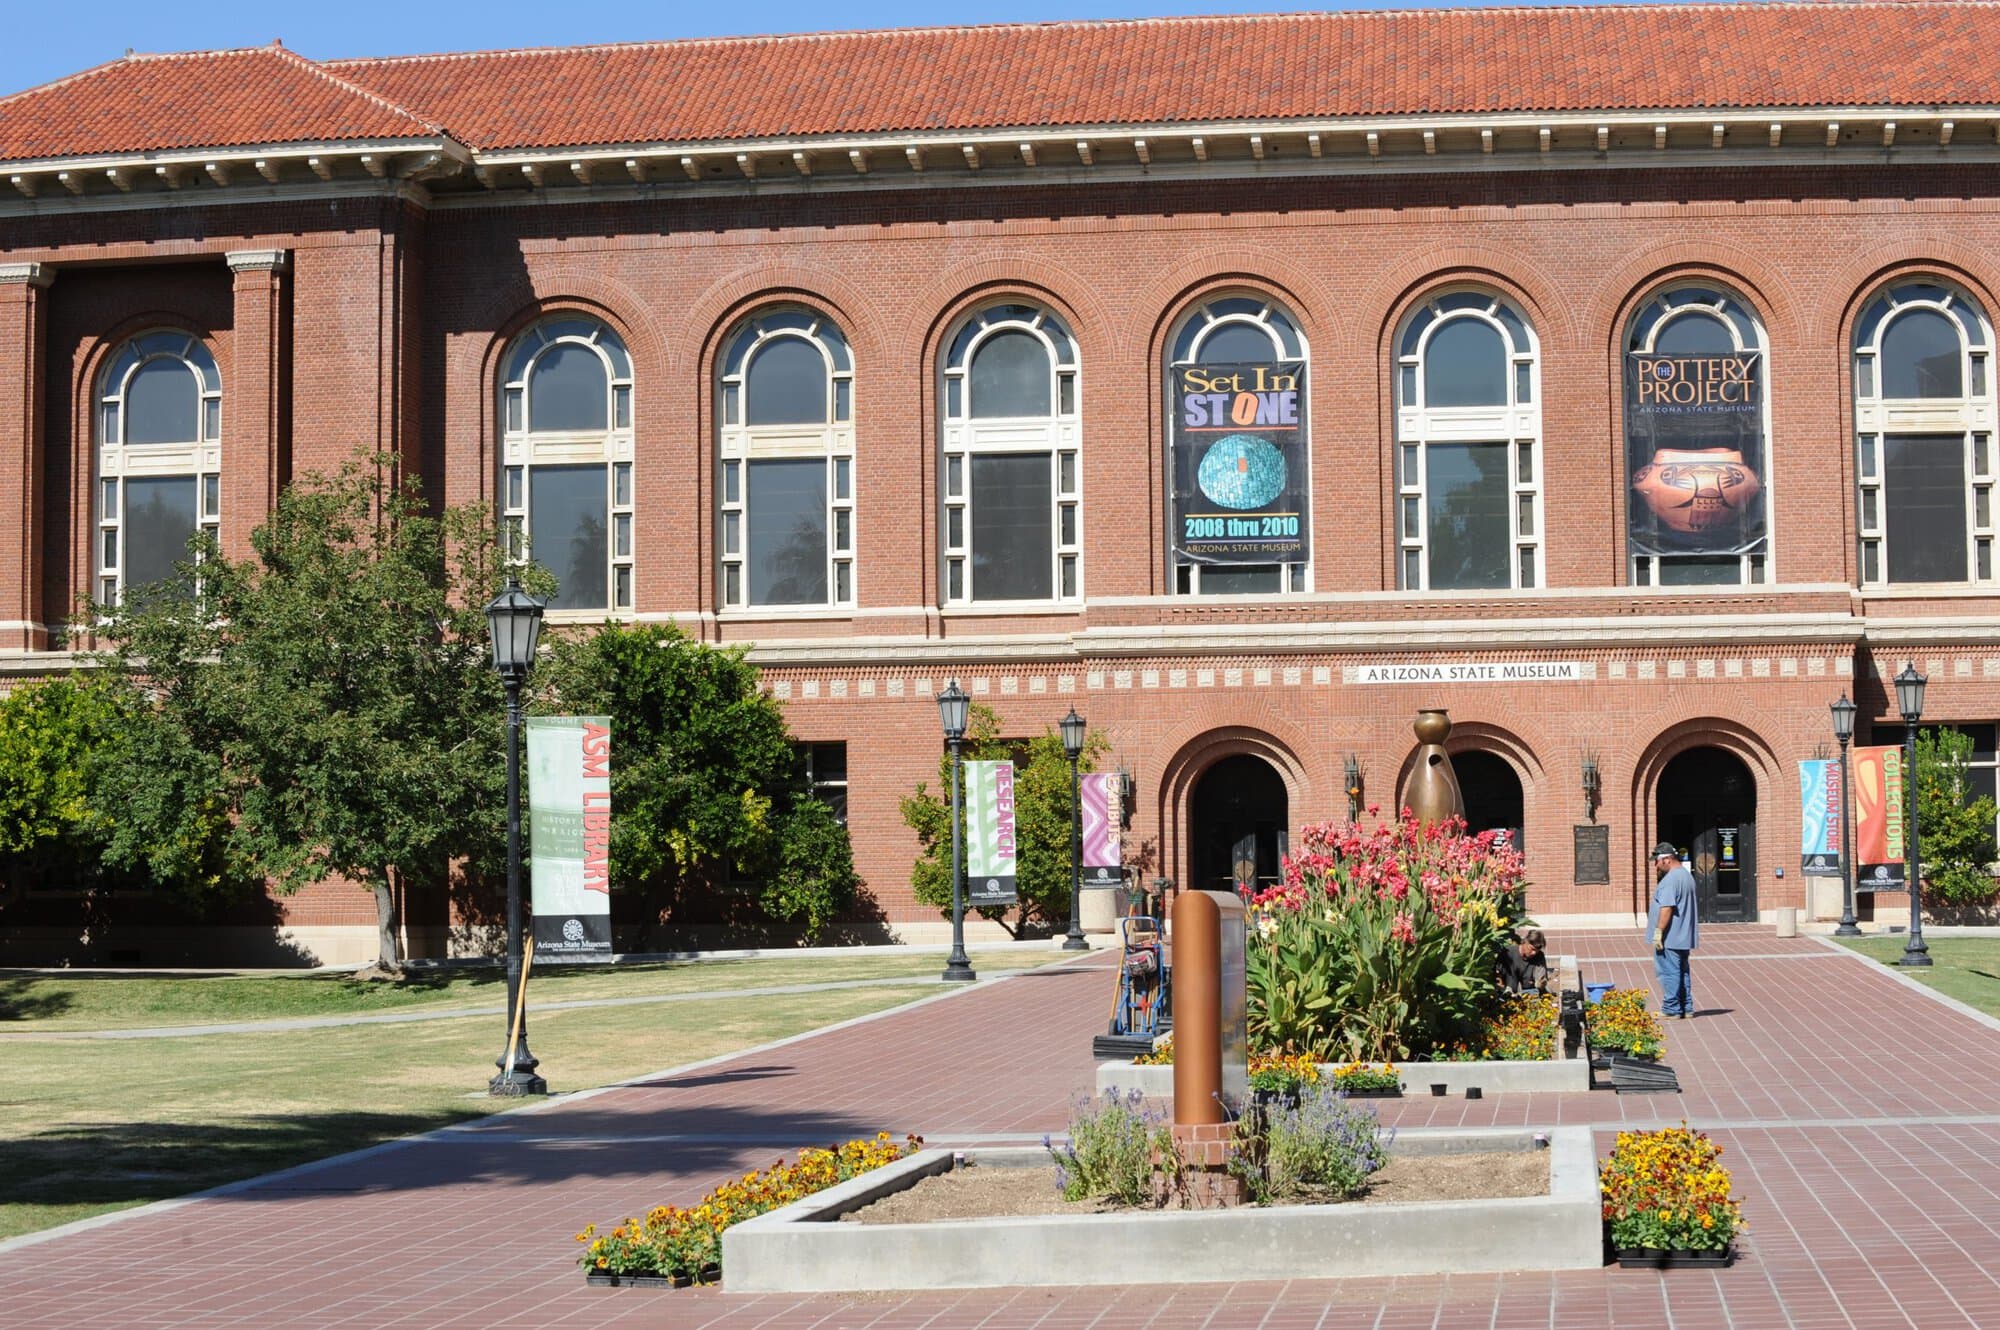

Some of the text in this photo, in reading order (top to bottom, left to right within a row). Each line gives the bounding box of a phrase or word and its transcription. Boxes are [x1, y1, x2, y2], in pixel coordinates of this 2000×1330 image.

[1184, 367, 1298, 393] Set In
[1638, 358, 1750, 382] POTTERY
[1657, 367, 1671, 377] THE
[1639, 380, 1754, 406] PROJECT
[1185, 392, 1298, 427] STONE
[1185, 516, 1298, 538] 2008 thru 2010
[1186, 543, 1300, 553] ARIZONA STATE MUSEUM
[1368, 665, 1572, 680] ARIZONA STATE MUSEUM
[582, 724, 609, 778] ASM
[996, 764, 1015, 858] RESEARCH
[1826, 763, 1841, 851] MUSEUM STORE
[1883, 750, 1904, 860] COLLECTIONS
[583, 792, 610, 894] LIBRARY
[564, 940, 581, 948] State
